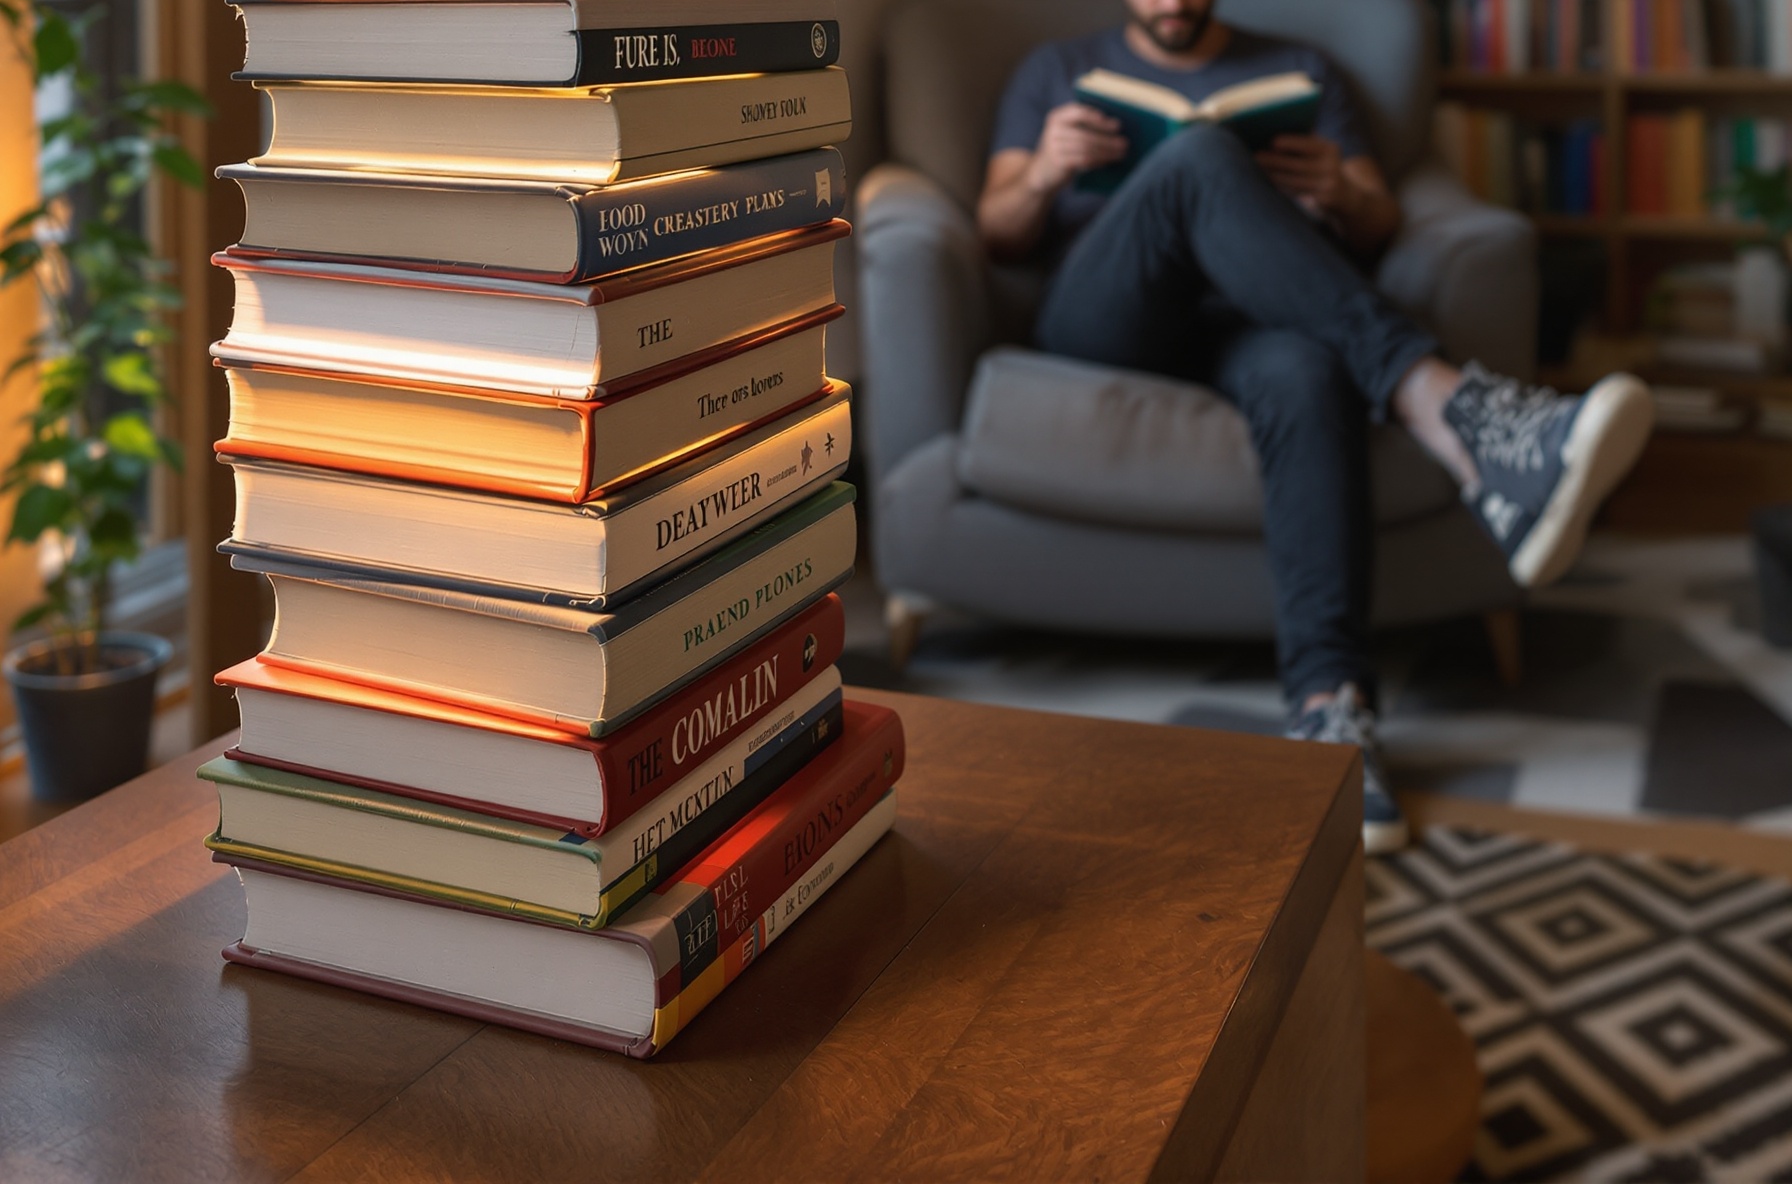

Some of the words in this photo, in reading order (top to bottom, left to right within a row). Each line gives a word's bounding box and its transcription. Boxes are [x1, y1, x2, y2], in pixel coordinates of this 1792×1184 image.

[614, 35, 660, 69] FURE
[653, 199, 741, 236] CREASTERY
[636, 318, 674, 349] THE
[671, 653, 779, 765] COMALIN
